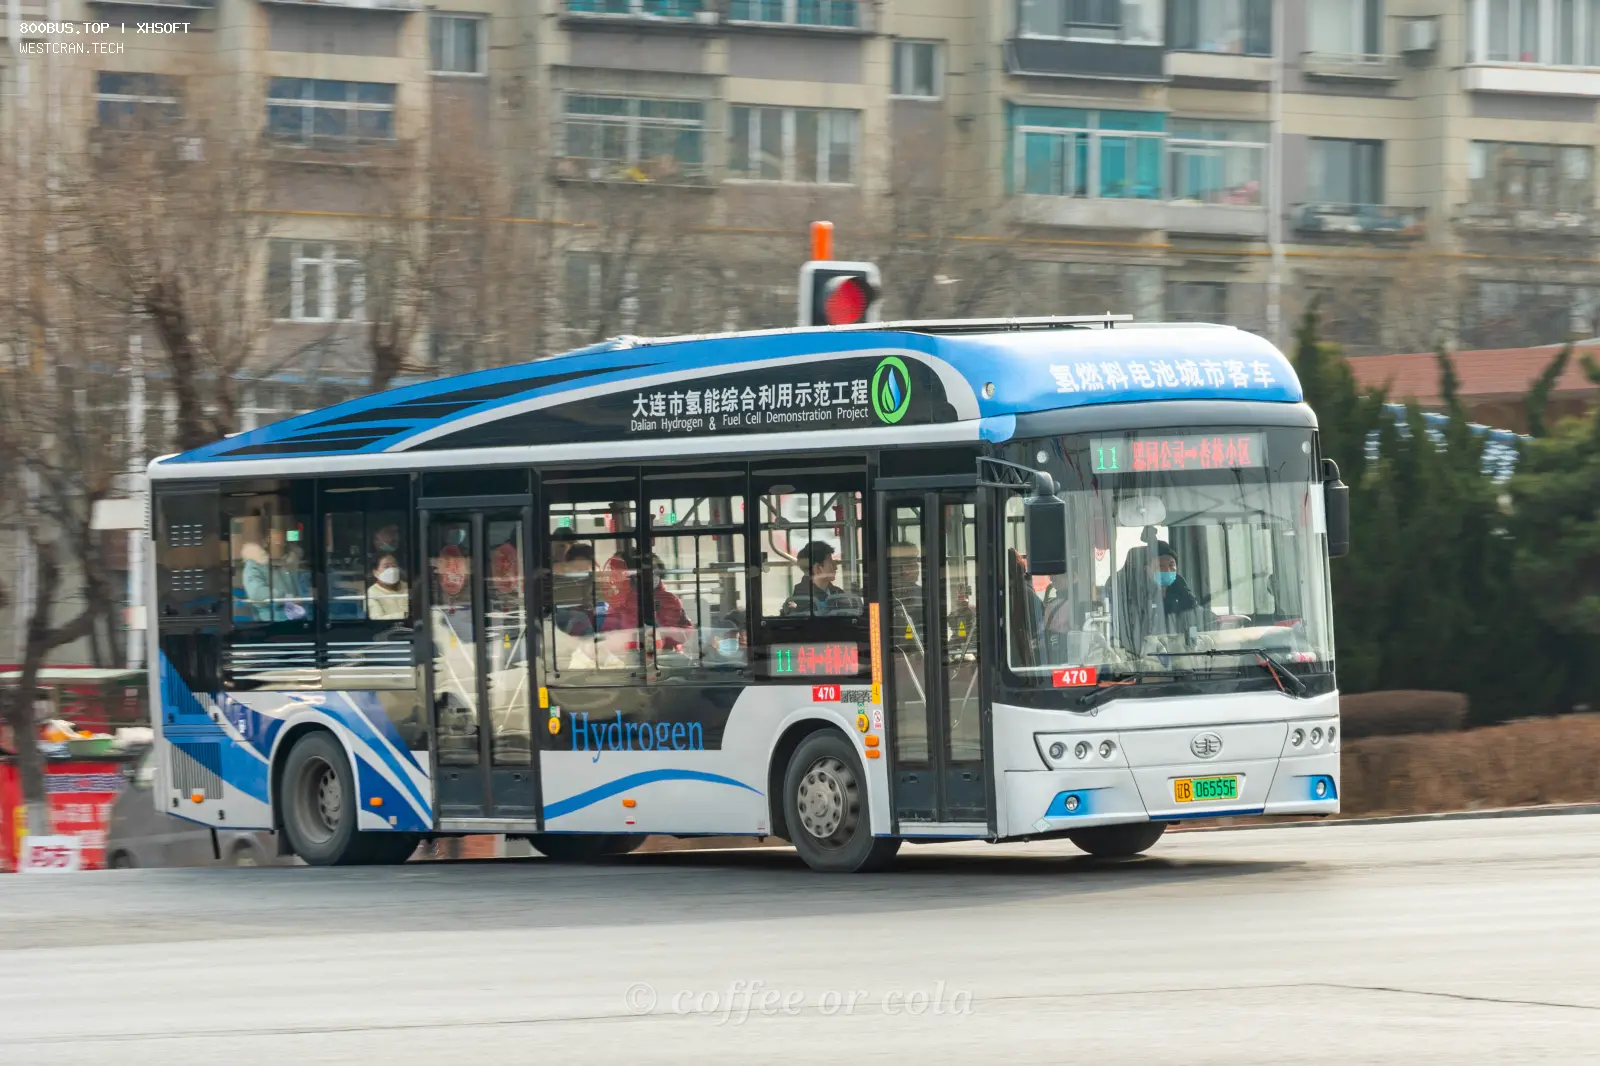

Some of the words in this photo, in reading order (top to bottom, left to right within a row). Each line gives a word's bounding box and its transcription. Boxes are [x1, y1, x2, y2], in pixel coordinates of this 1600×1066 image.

[1049, 359, 1276, 393] 氢燃料电池城市客车
[631, 378, 869, 418] 大连市氢能综合利用示范工程
[631, 418, 657, 432] Dalian
[661, 417, 703, 432] Hydrogen
[708, 418, 717, 431] &
[722, 413, 741, 427] Fuel
[745, 411, 762, 425] Cell
[766, 408, 832, 423] Demonstration
[837, 406, 869, 421] Project
[1096, 446, 1120, 471] 11
[776, 649, 793, 673] 11
[1062, 670, 1087, 684] 470
[818, 686, 835, 700] 470
[569, 710, 705, 763] Hydrogen
[1195, 779, 1236, 798] 06555F
